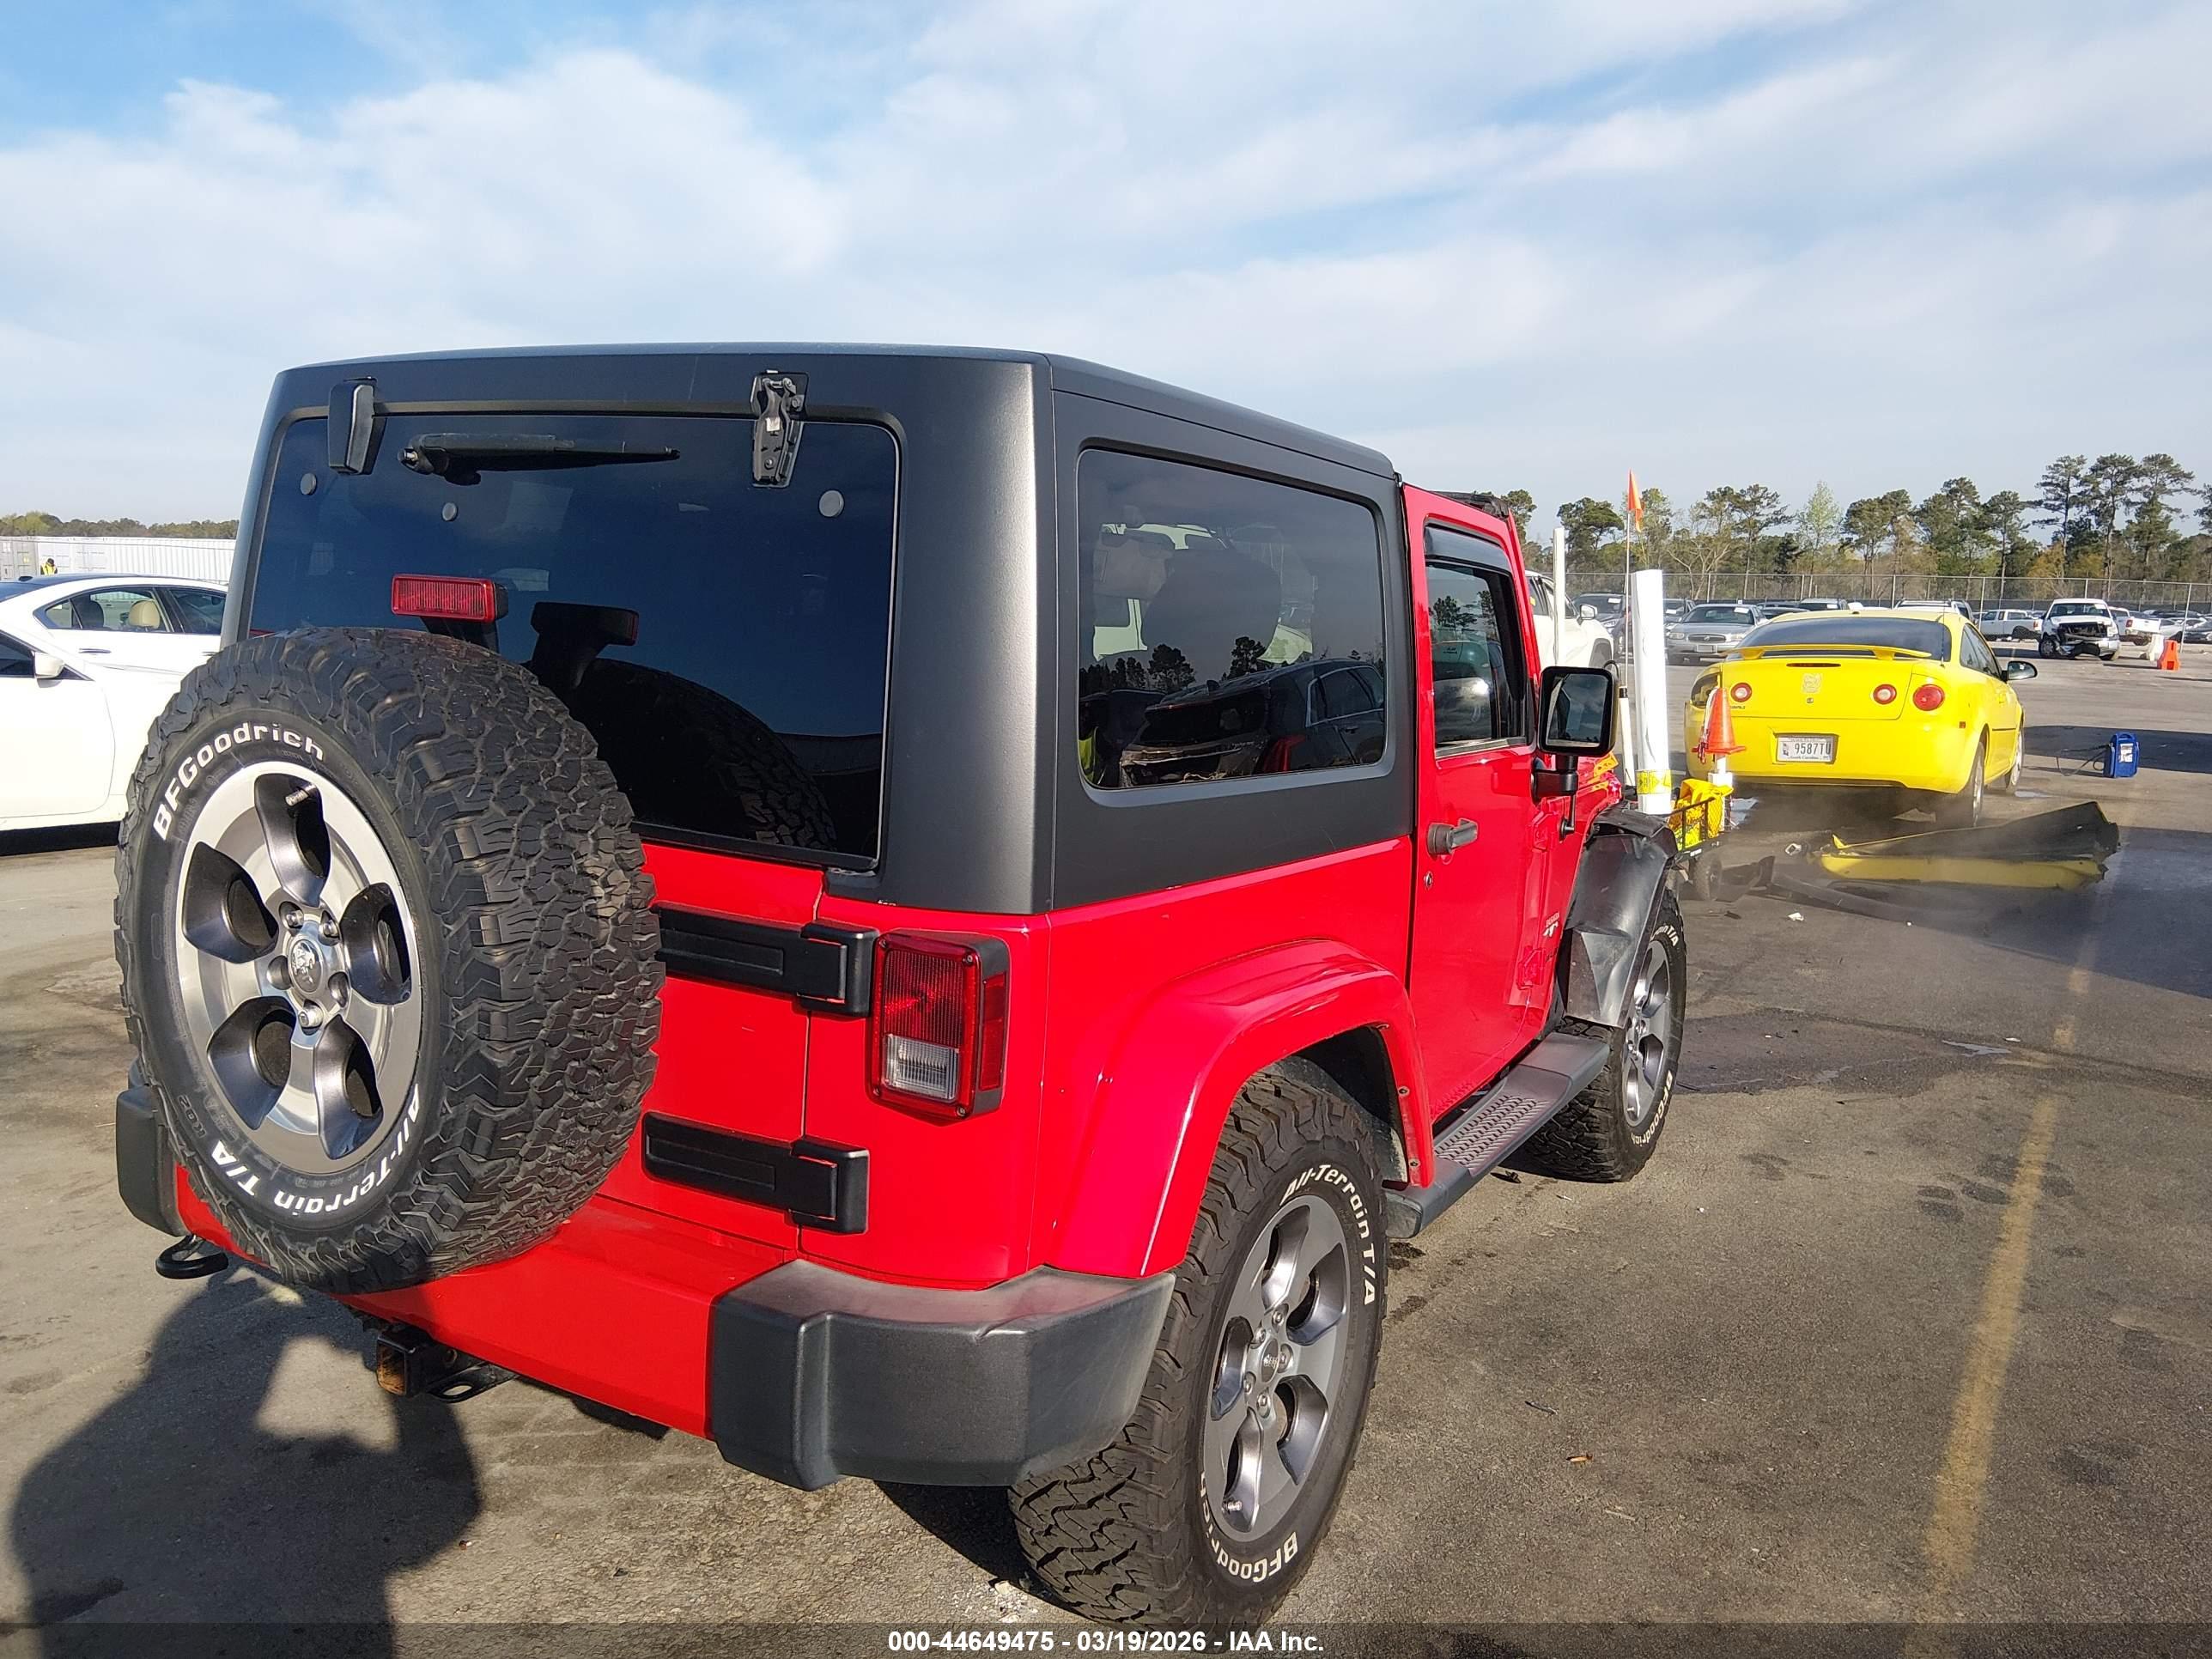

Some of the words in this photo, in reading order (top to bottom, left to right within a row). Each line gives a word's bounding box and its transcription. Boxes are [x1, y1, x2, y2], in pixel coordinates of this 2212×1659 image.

[153, 722, 325, 841] BFGoodrich
[1794, 741, 1832, 756] 9587TU
[1667, 925, 1679, 946] T/A
[274, 1083, 420, 1216] All-Terrain
[1631, 1069, 1674, 1147] BFGoodrich
[211, 1139, 262, 1196] T/A
[1279, 1164, 1370, 1239] All-Terrain
[1363, 1243, 1376, 1305] T/A
[1200, 1471, 1299, 1583] BFGoodrich
